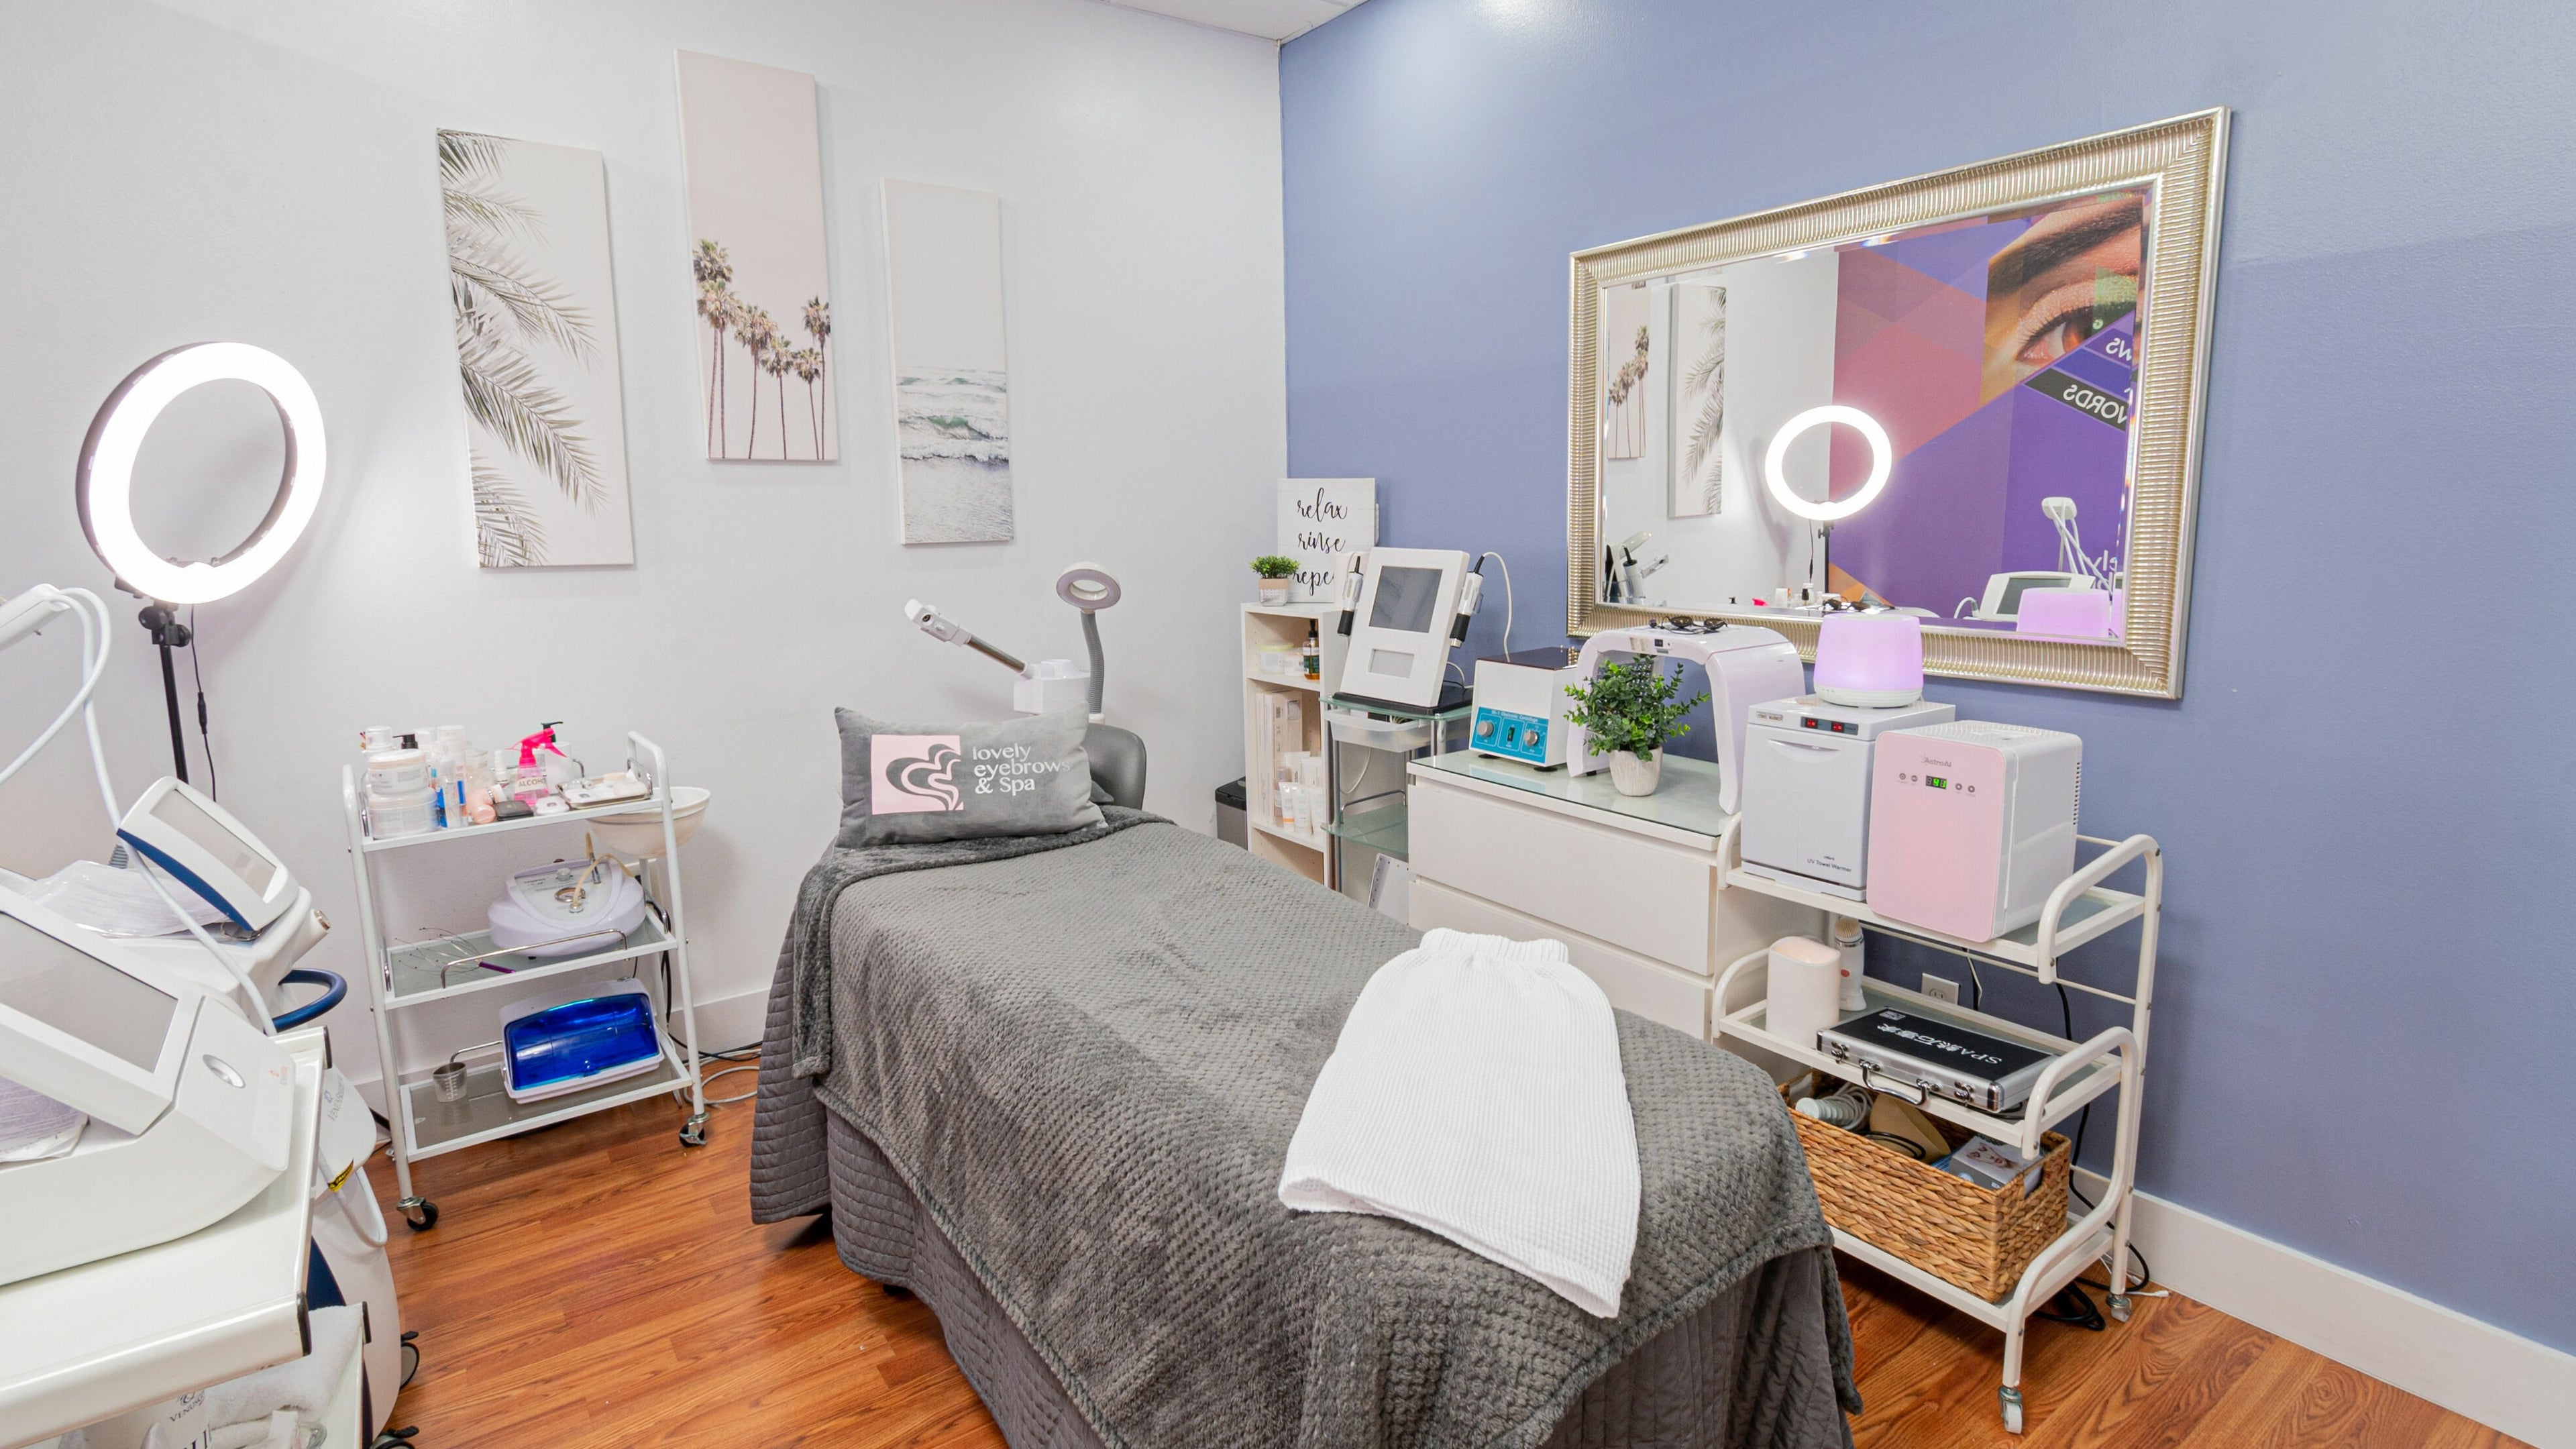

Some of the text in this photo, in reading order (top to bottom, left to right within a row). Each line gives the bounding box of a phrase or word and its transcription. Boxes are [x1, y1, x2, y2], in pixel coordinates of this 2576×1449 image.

[1297, 487, 1348, 523] relax
[1297, 531, 1346, 554] rinse
[1292, 570, 1334, 596] repe
[973, 743, 1031, 762] lovely
[974, 758, 1071, 781] eyebrows
[975, 776, 1035, 796] & Spa
